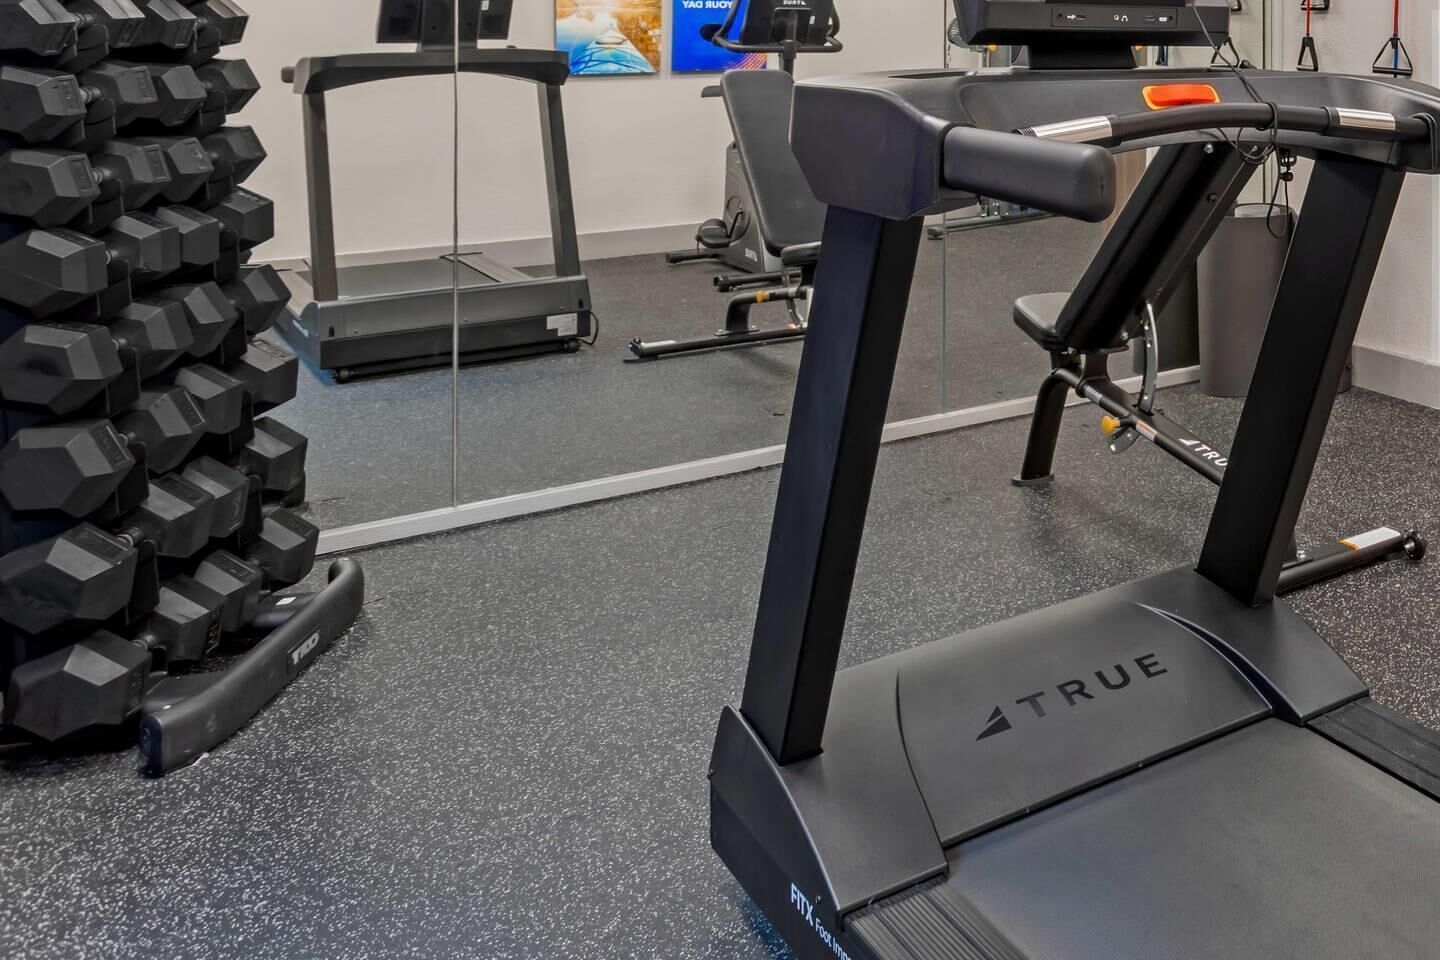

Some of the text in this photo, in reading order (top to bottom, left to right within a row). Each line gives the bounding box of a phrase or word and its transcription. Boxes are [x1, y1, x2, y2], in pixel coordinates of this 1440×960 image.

[1195, 444, 1228, 467] TRU
[1015, 653, 1168, 718] TRUE
[790, 882, 814, 926] FITX
[815, 917, 833, 947] Foot
